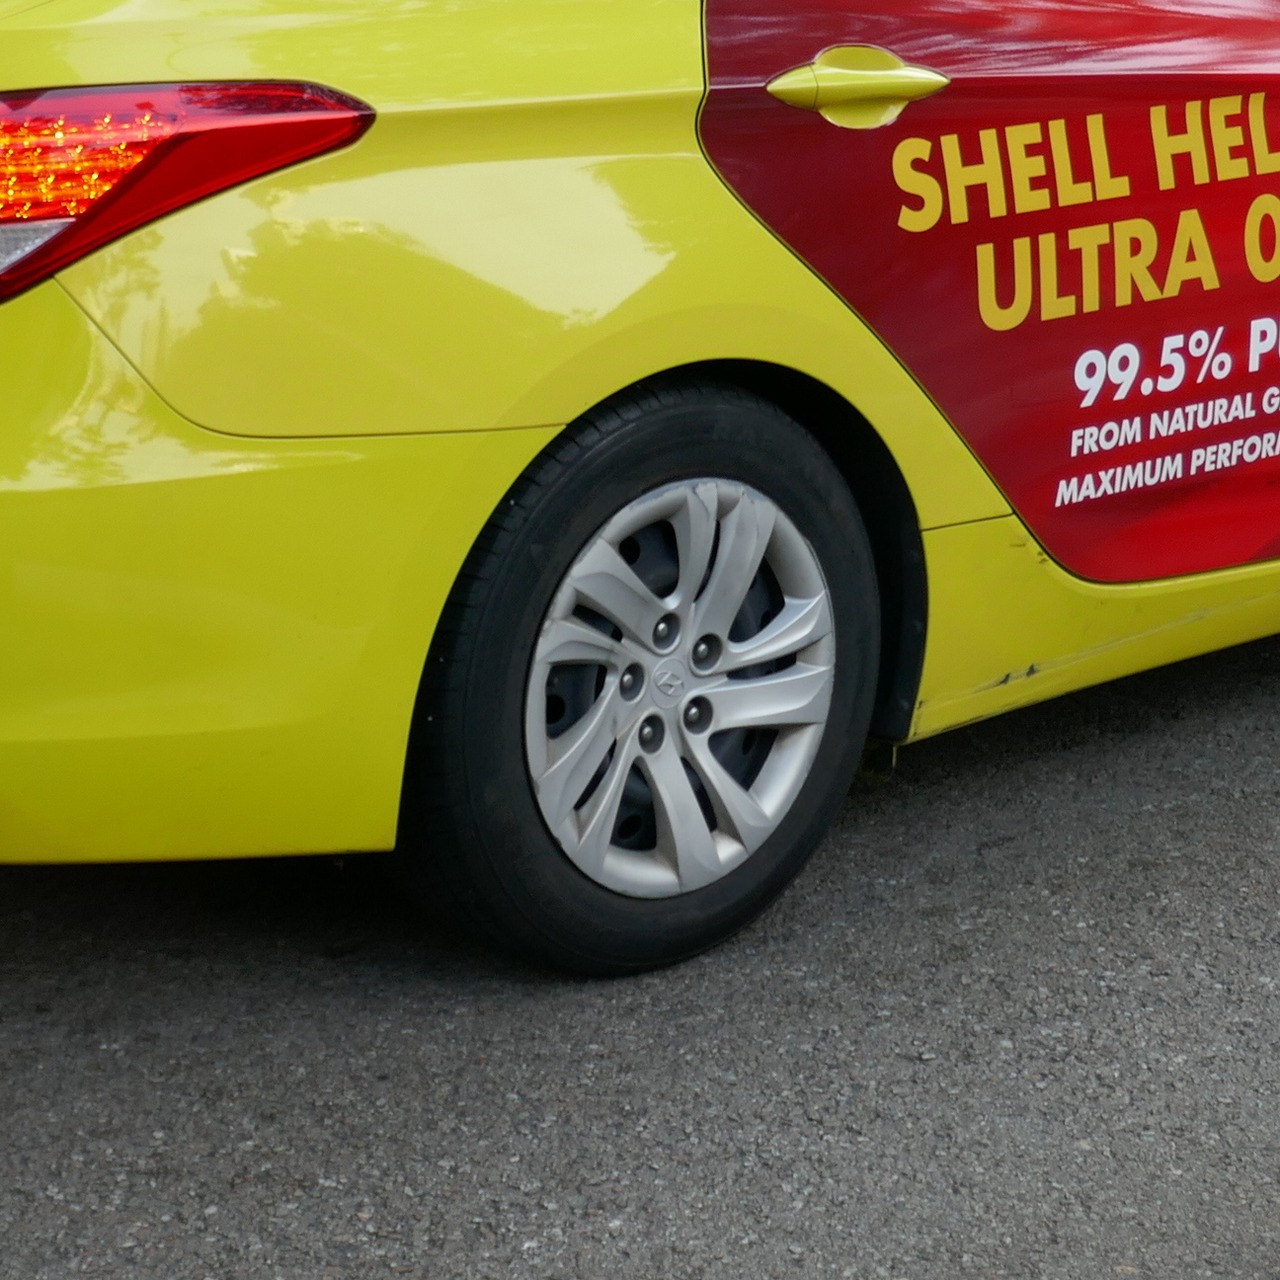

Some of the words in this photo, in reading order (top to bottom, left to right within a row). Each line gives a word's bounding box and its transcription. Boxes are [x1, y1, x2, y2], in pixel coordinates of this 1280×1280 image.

[891, 113, 1131, 233] SHELL
[975, 208, 1220, 331] ULTRA
[1074, 325, 1232, 409] 99.5%
[1070, 416, 1142, 458] FROM
[1149, 392, 1256, 440] NATURAL
[1054, 453, 1183, 509] MAXIMUM
